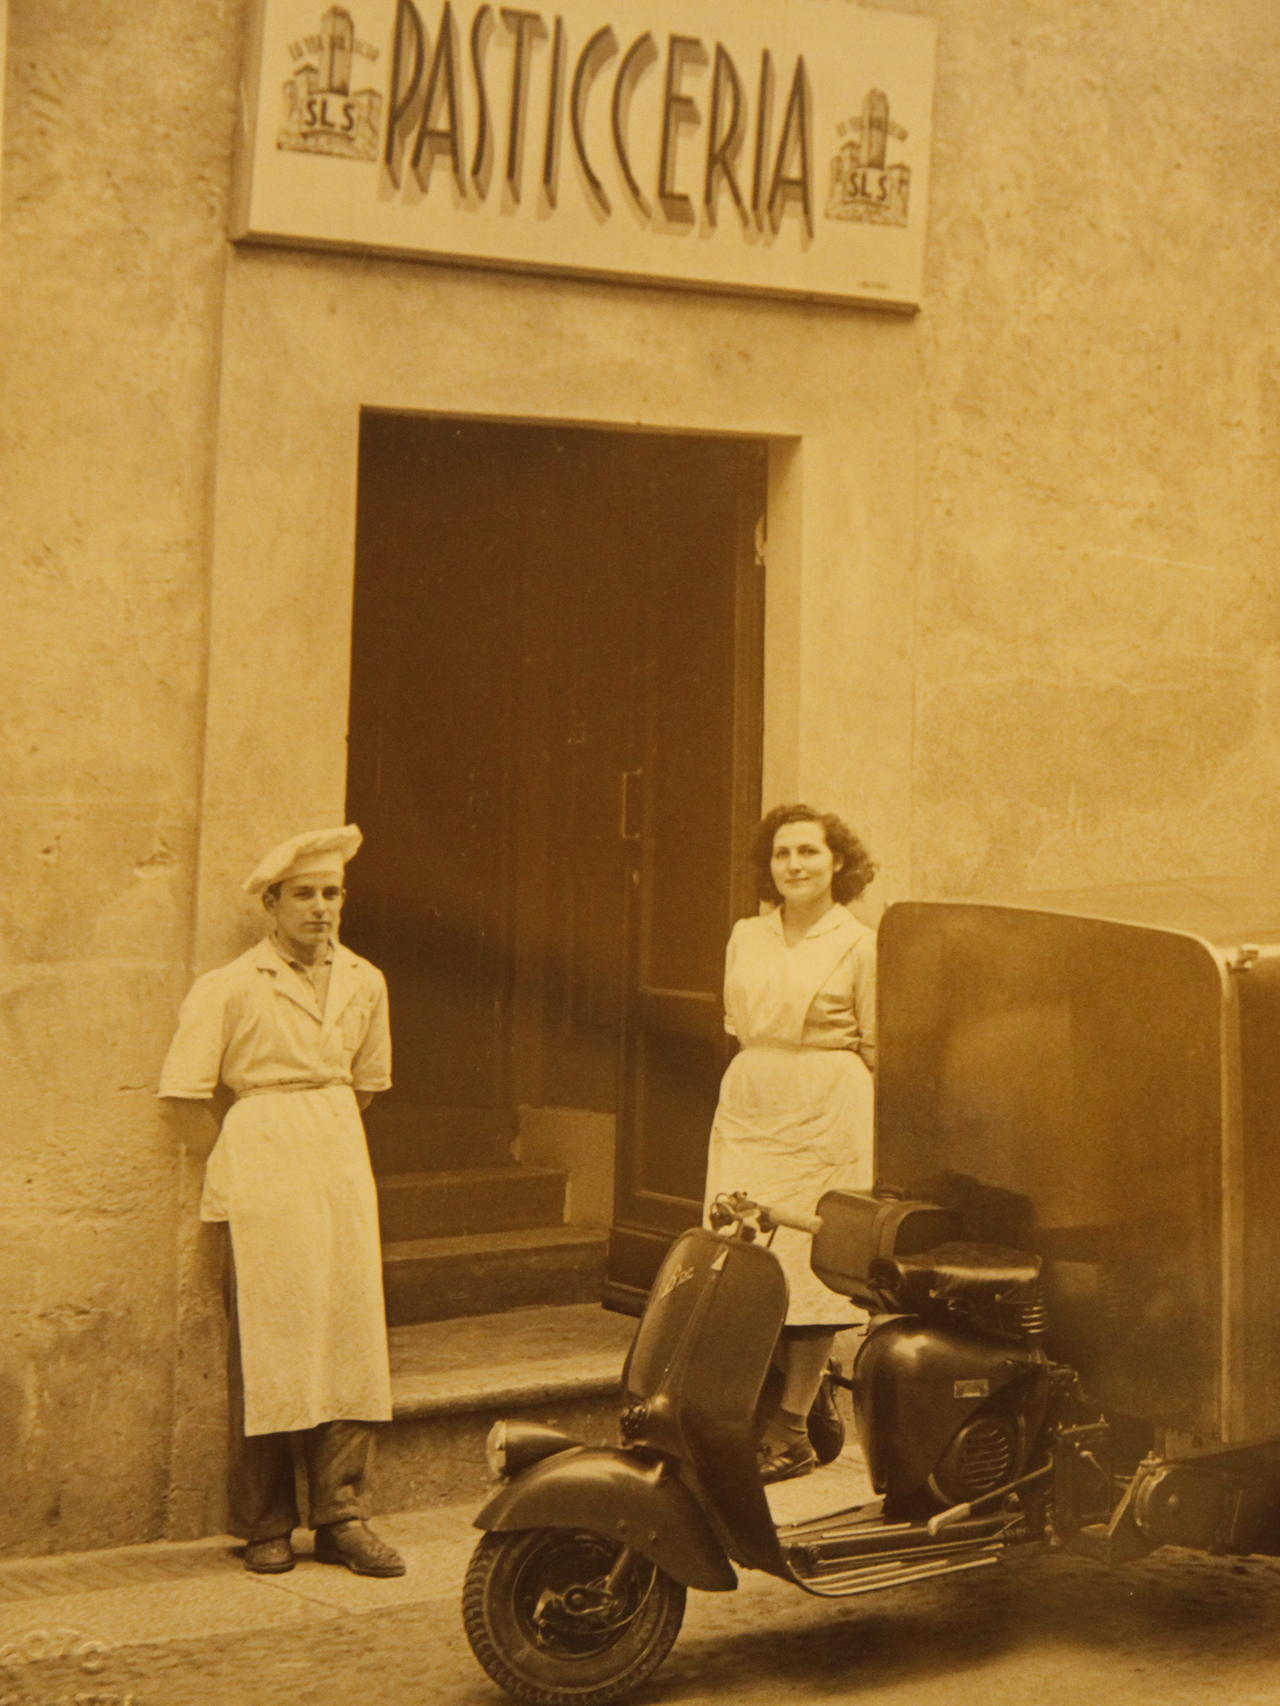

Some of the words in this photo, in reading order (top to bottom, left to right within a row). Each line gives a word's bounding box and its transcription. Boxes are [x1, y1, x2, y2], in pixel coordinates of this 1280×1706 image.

[303, 97, 356, 133] SLS
[383, 0, 815, 240] PASTICCERIA
[847, 171, 889, 202] SLS
